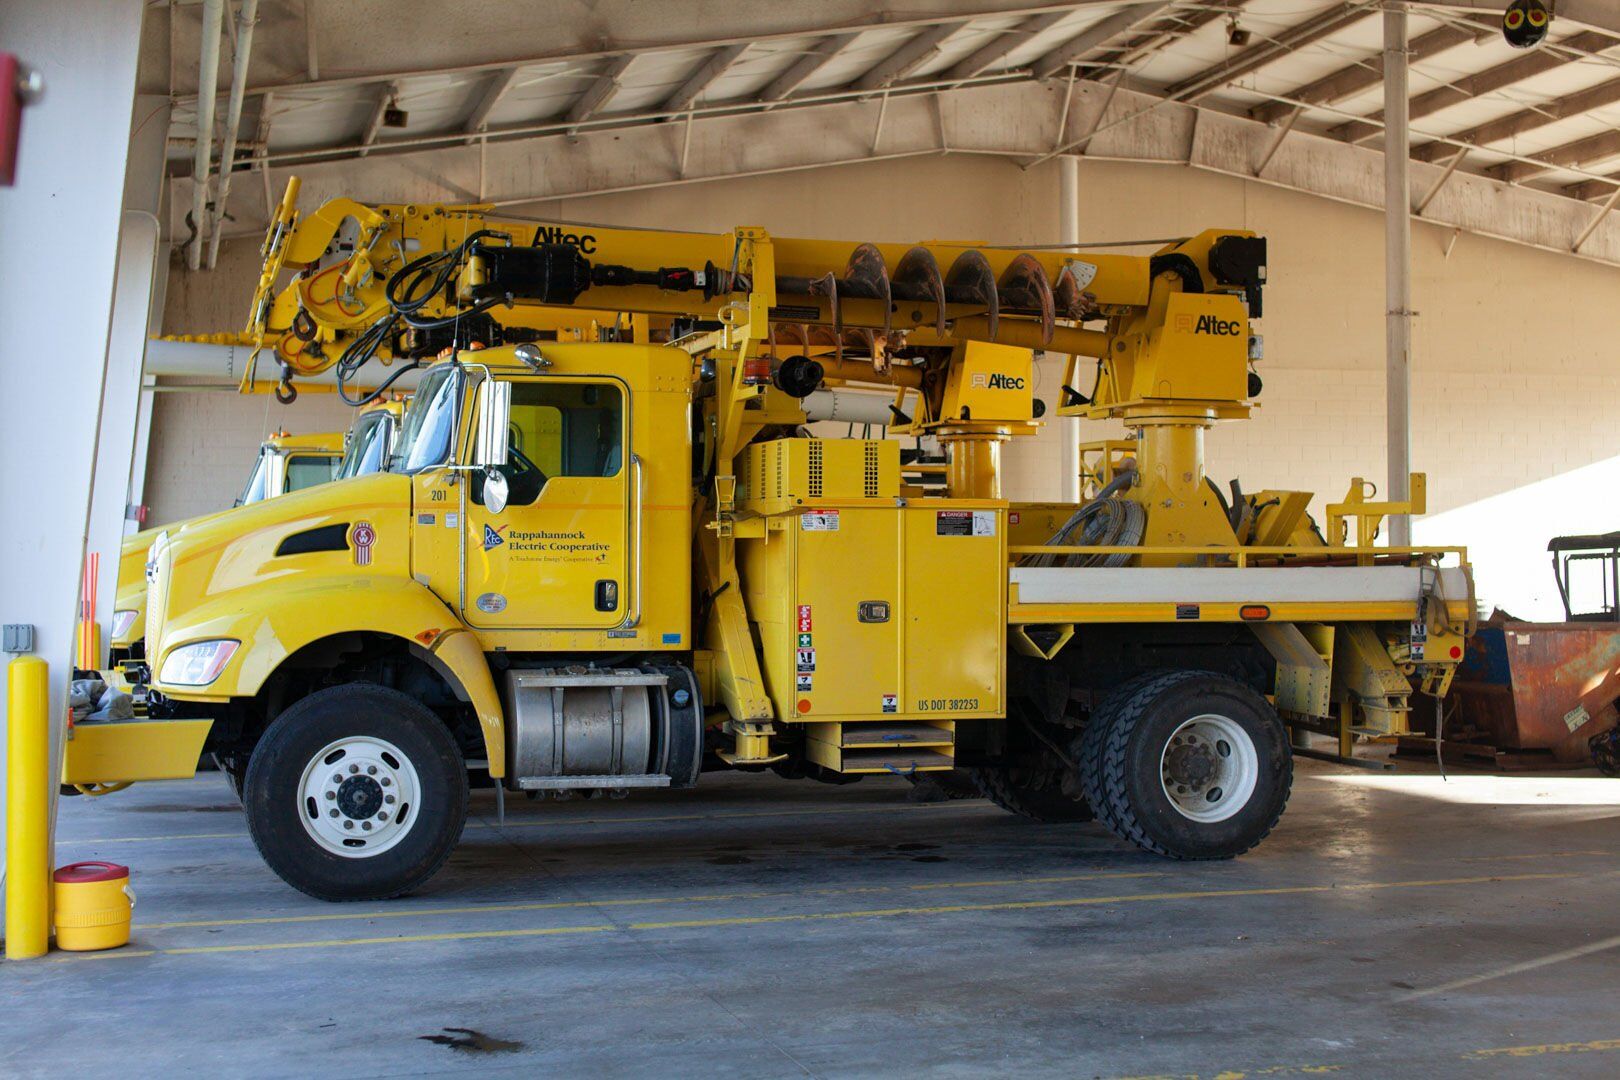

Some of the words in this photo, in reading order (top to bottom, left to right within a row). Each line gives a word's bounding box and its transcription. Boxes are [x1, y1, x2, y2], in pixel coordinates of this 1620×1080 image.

[532, 227, 596, 253] Altec
[1195, 315, 1240, 336] Altec
[988, 374, 1024, 389] Altec
[431, 490, 446, 501] 201
[509, 531, 585, 540] Rappahannock
[509, 542, 546, 550] Electric
[550, 542, 610, 552] Cooperative
[918, 700, 928, 710] US
[931, 700, 946, 710] DOT
[949, 699, 979, 710] 382253
